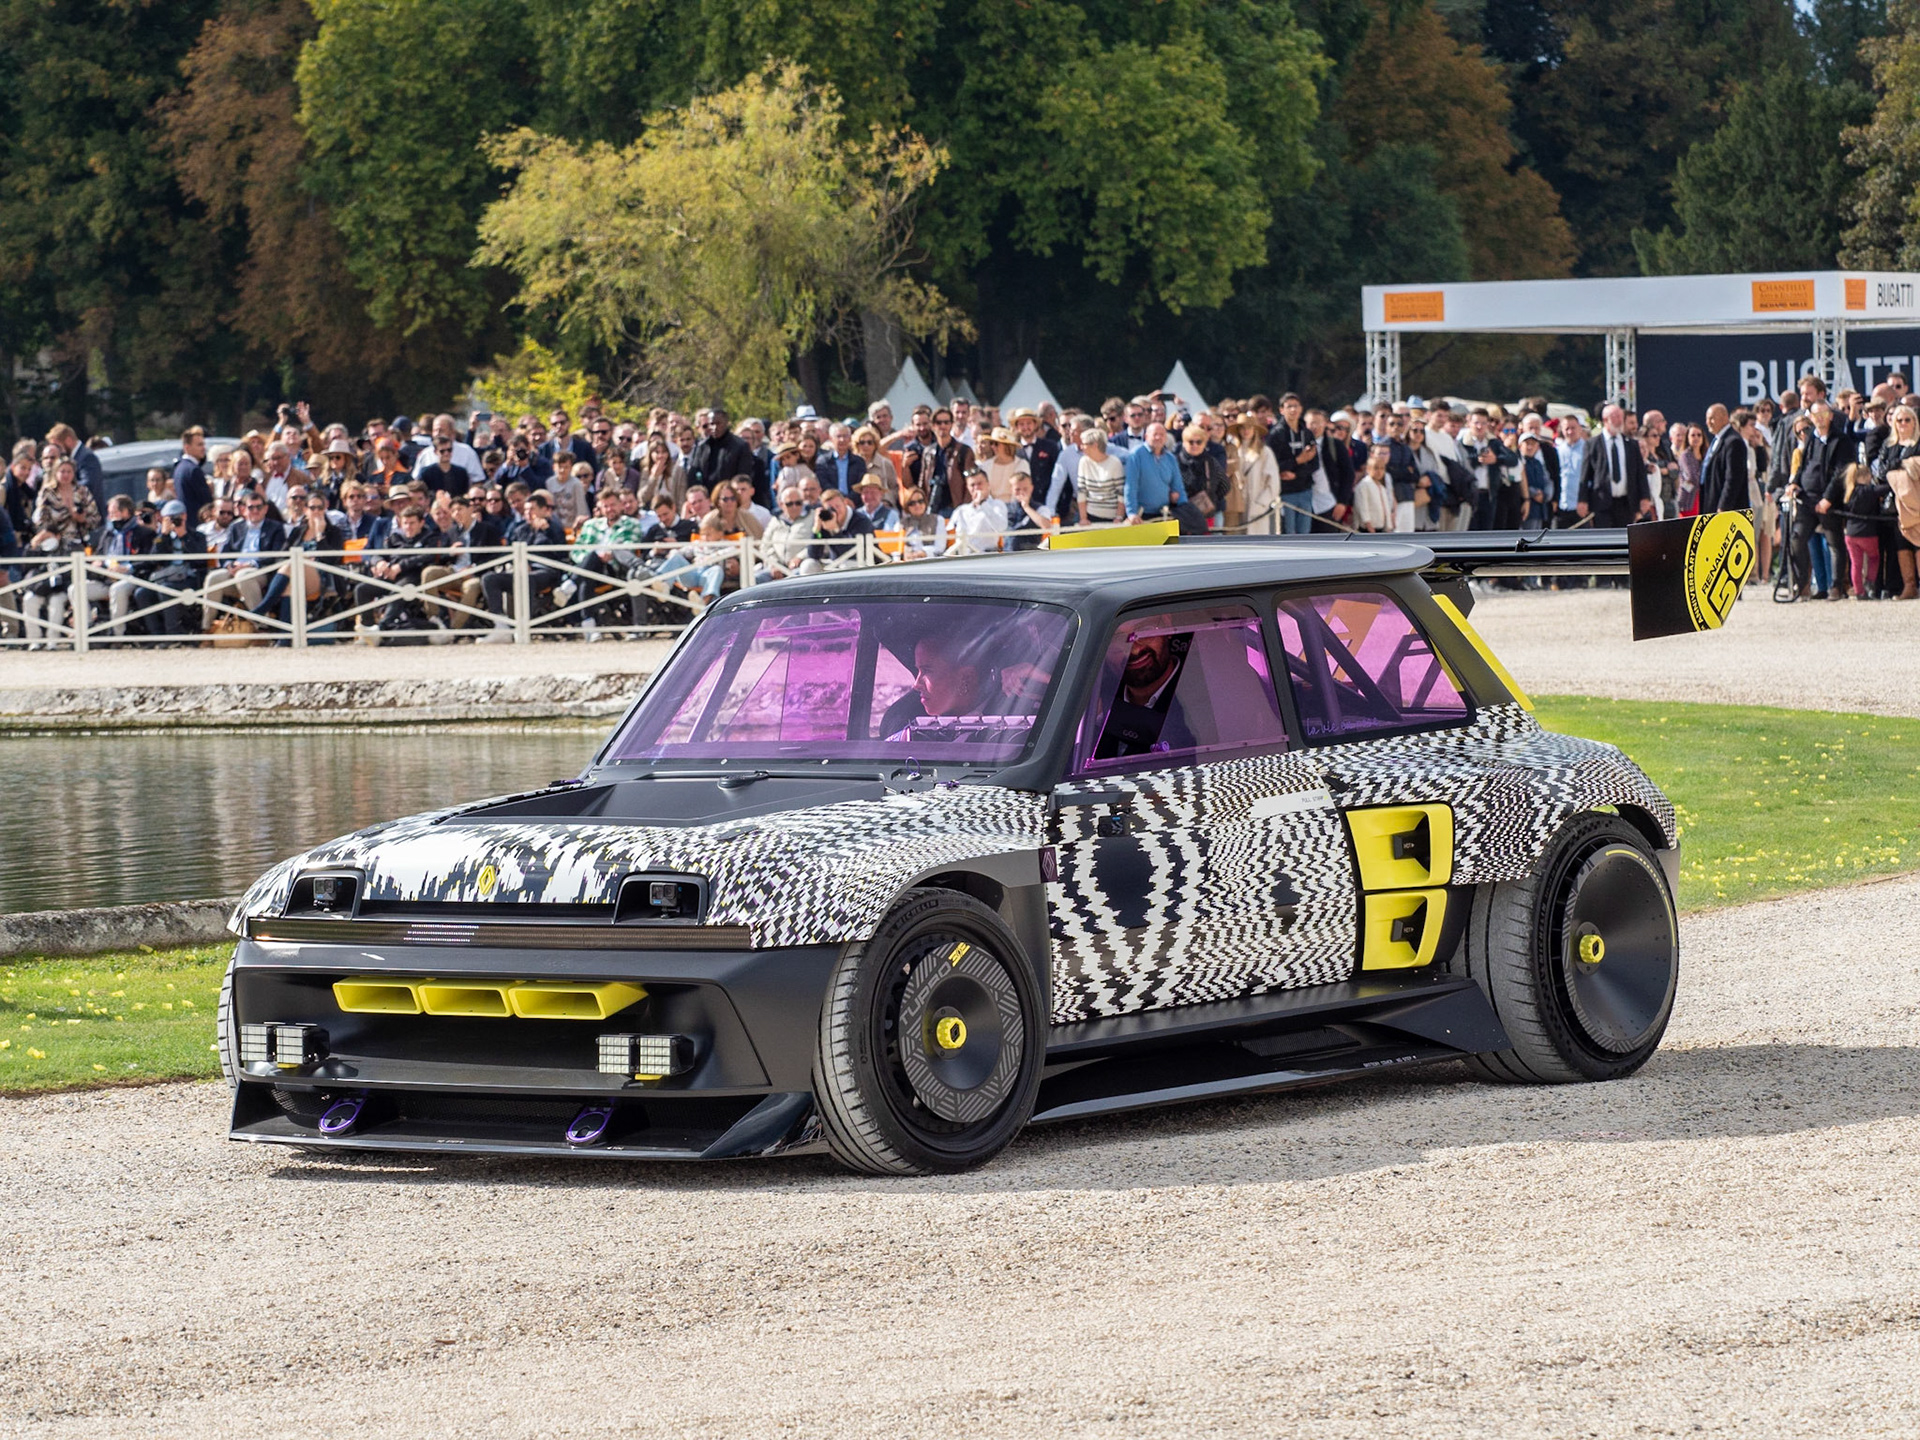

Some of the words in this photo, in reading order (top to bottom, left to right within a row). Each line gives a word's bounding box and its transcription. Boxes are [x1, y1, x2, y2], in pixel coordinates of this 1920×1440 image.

[1877, 283, 1914, 307] BUGATTI
[1688, 549, 1704, 623] ANNIVERSARY
[1702, 532, 1732, 594] RENAULT
[1729, 522, 1736, 534] 5
[1709, 537, 1750, 622] 50
[895, 900, 939, 928] MICHELIN
[900, 961, 952, 1025] TURBO
